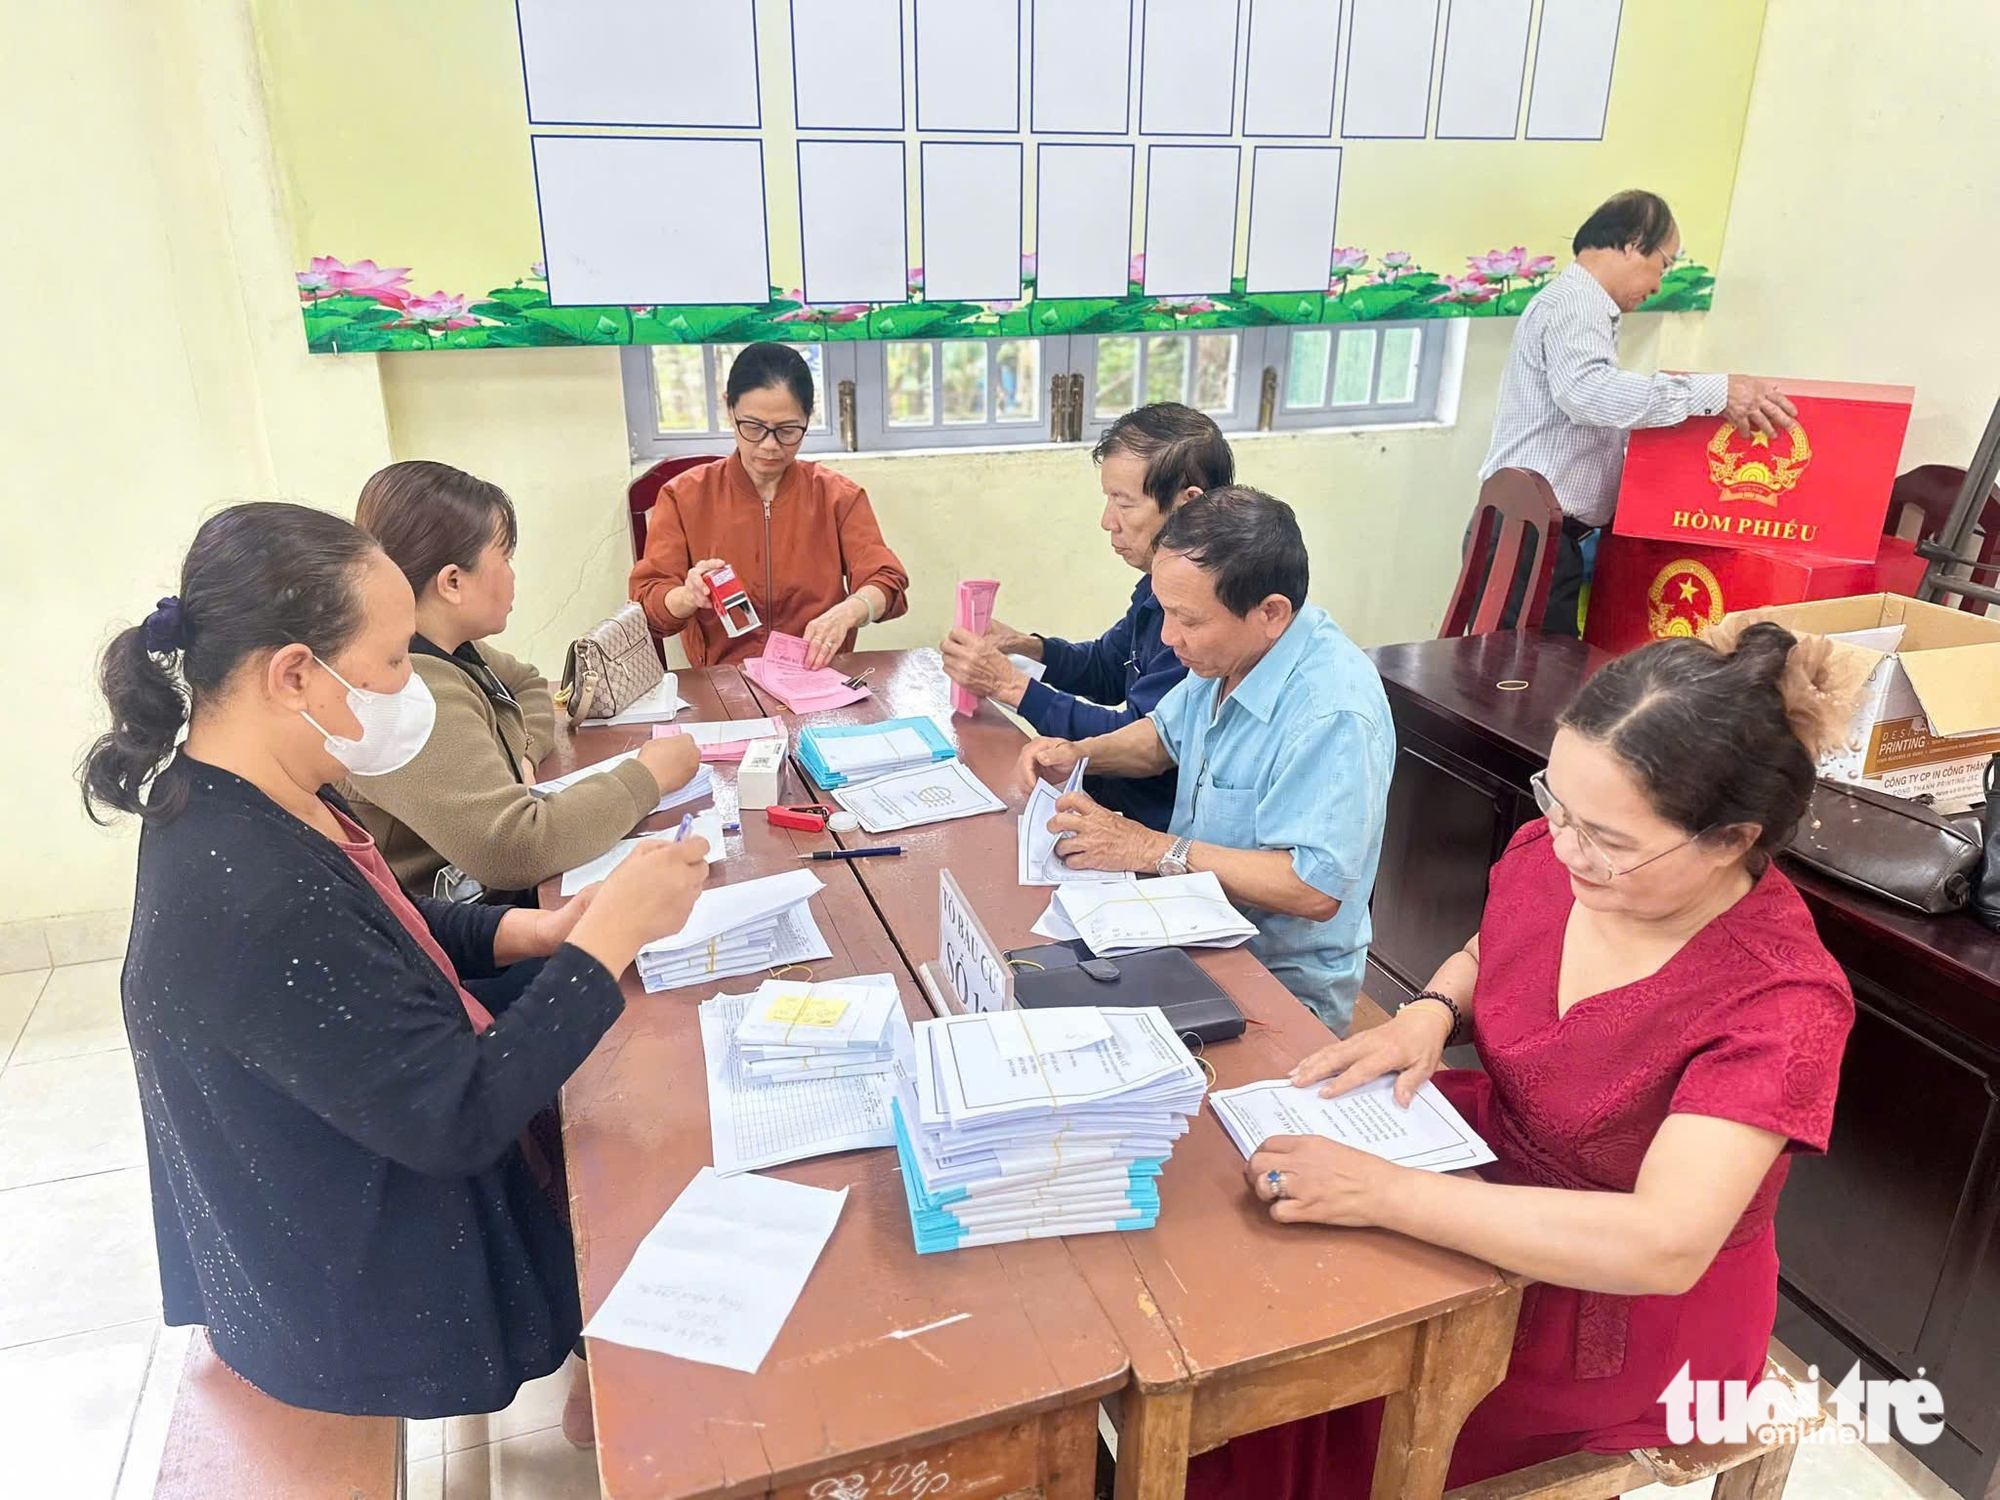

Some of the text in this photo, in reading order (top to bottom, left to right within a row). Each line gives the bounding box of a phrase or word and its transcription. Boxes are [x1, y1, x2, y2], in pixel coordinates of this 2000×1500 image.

[1672, 508, 1731, 532] HÒM
[1879, 736, 1926, 756] PRINTING
[1884, 776, 1906, 788] CÔNG
[1909, 773, 1918, 784] TY
[1920, 772, 1931, 782] CP
[1932, 770, 1941, 779] IN
[1942, 765, 1964, 778] CÔNG
[947, 941, 989, 1014] SỐ 1
